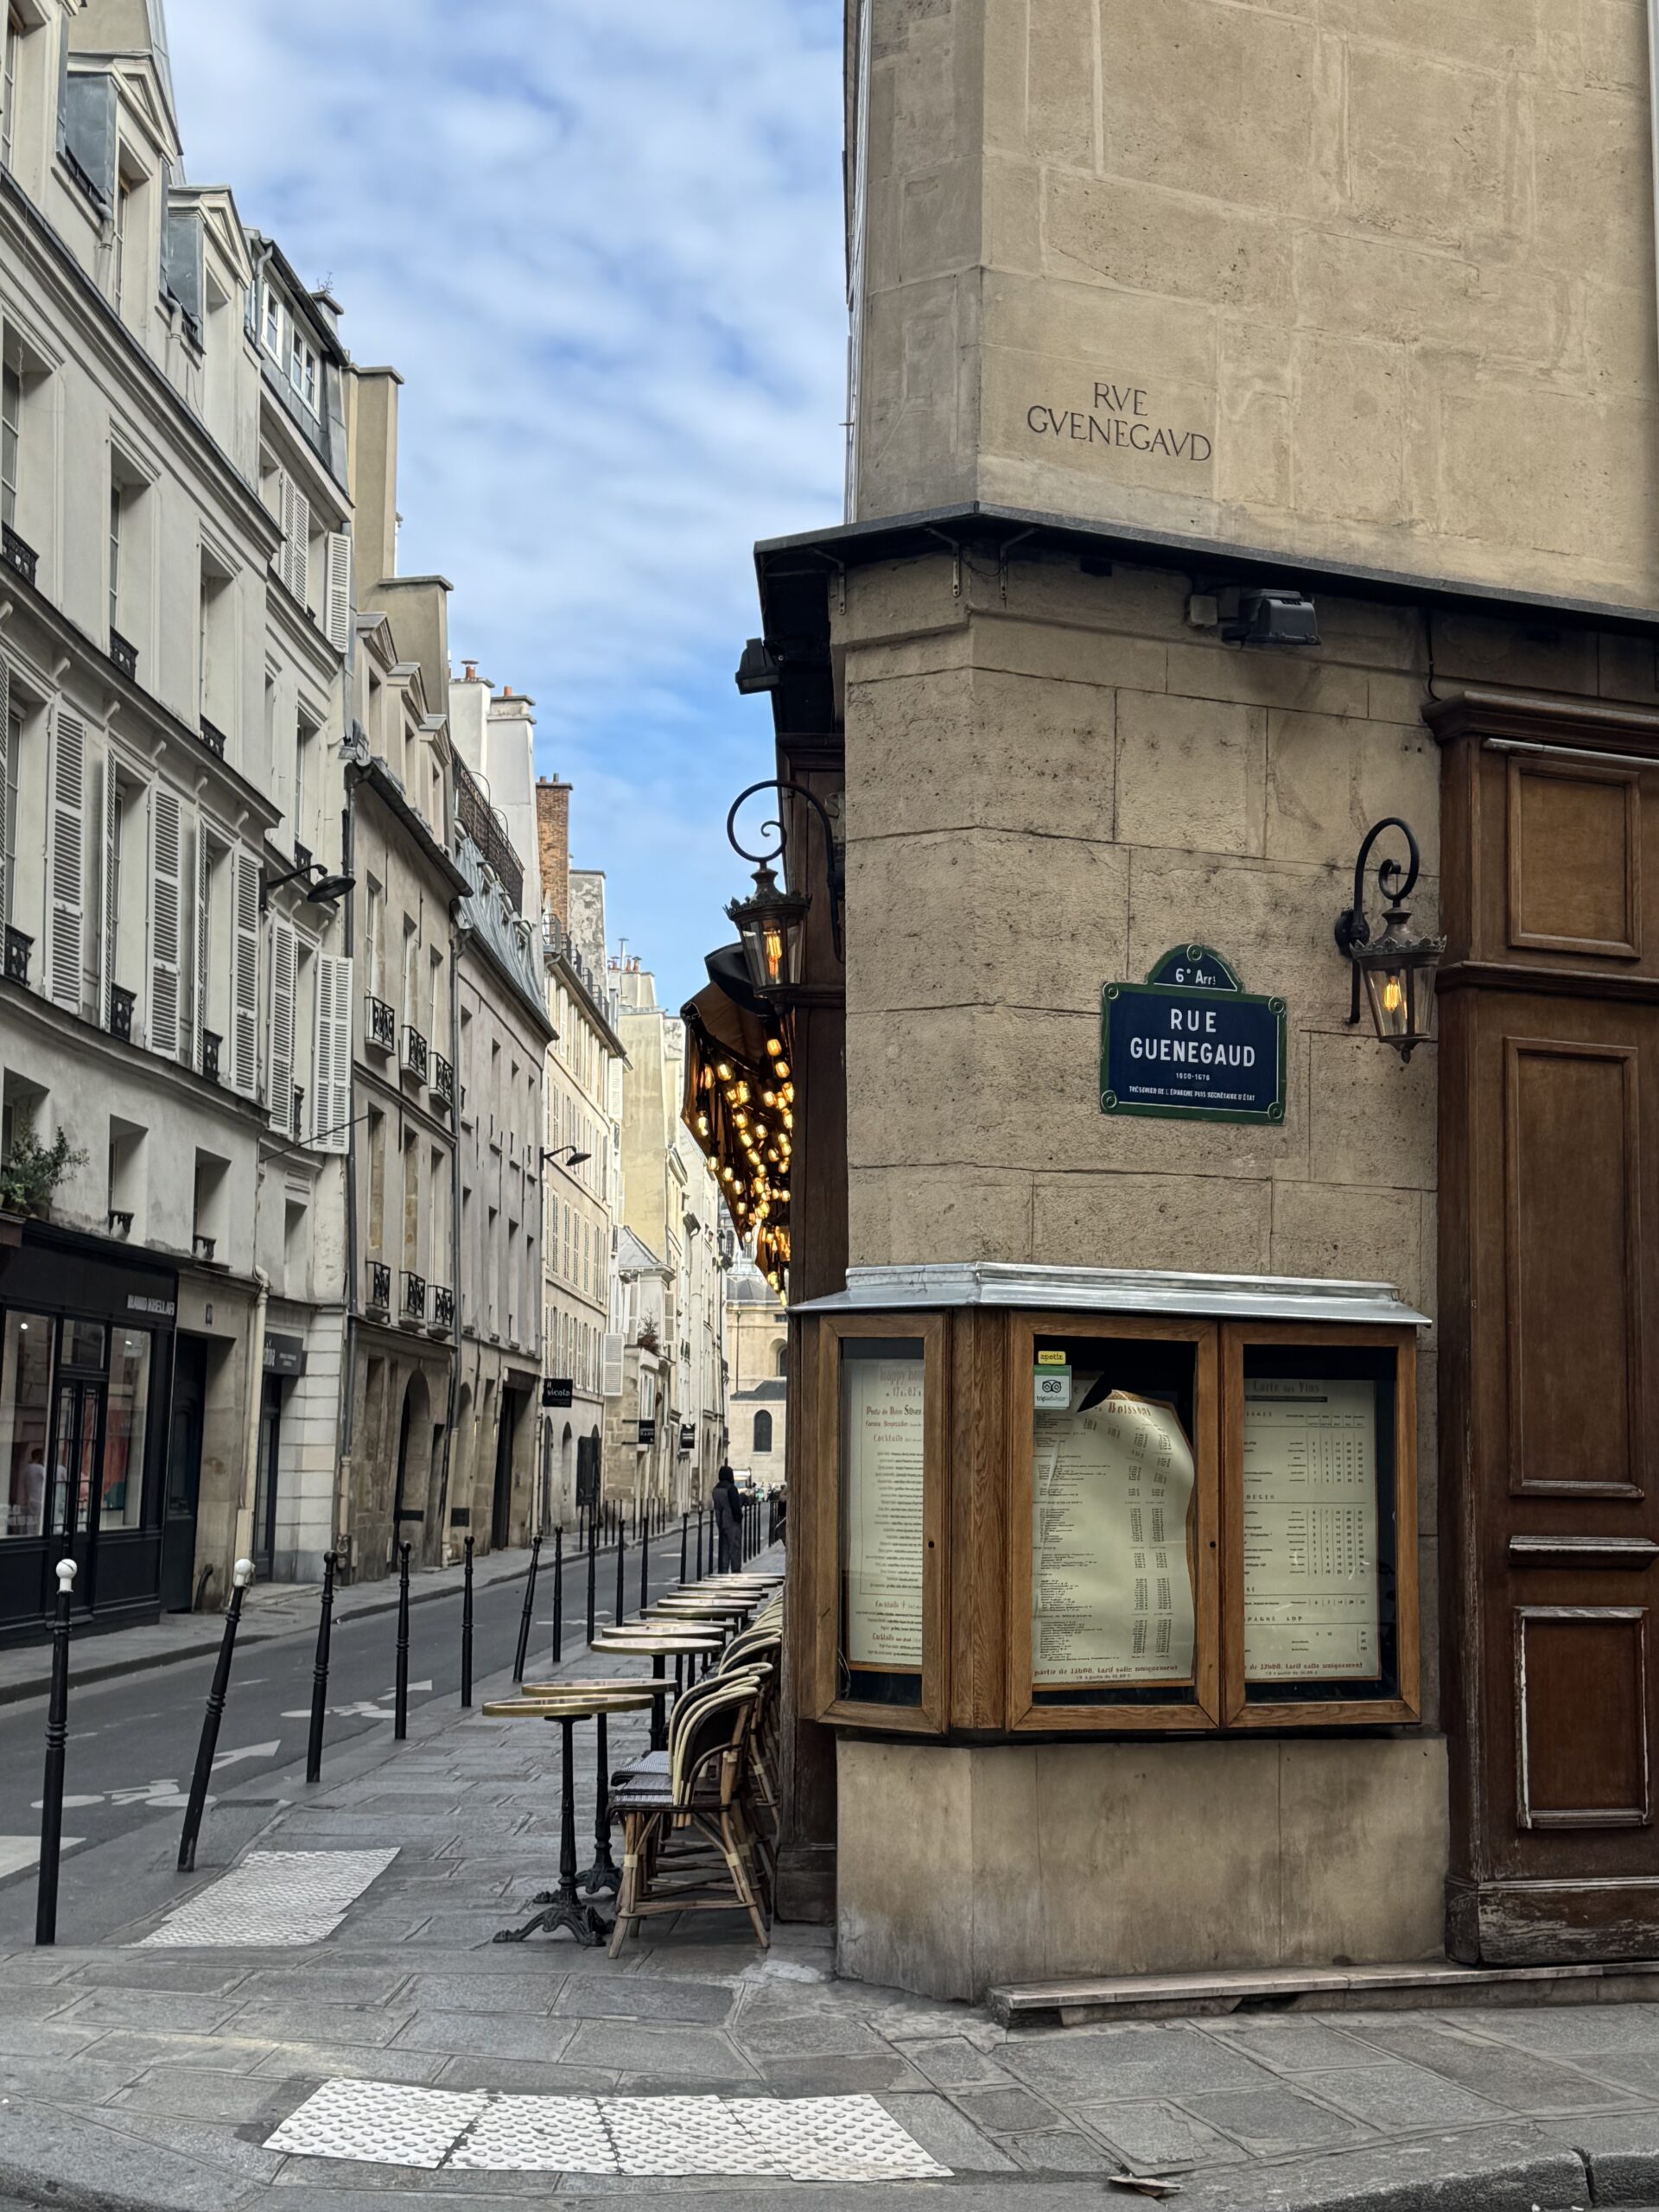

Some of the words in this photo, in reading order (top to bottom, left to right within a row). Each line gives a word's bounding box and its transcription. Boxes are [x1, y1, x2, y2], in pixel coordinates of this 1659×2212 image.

[1094, 382, 1147, 416] RVE
[1027, 405, 1211, 461] GVENEGAVD
[1171, 1008, 1217, 1033] RUE
[1130, 1037, 1255, 1067] GUENEGAUD
